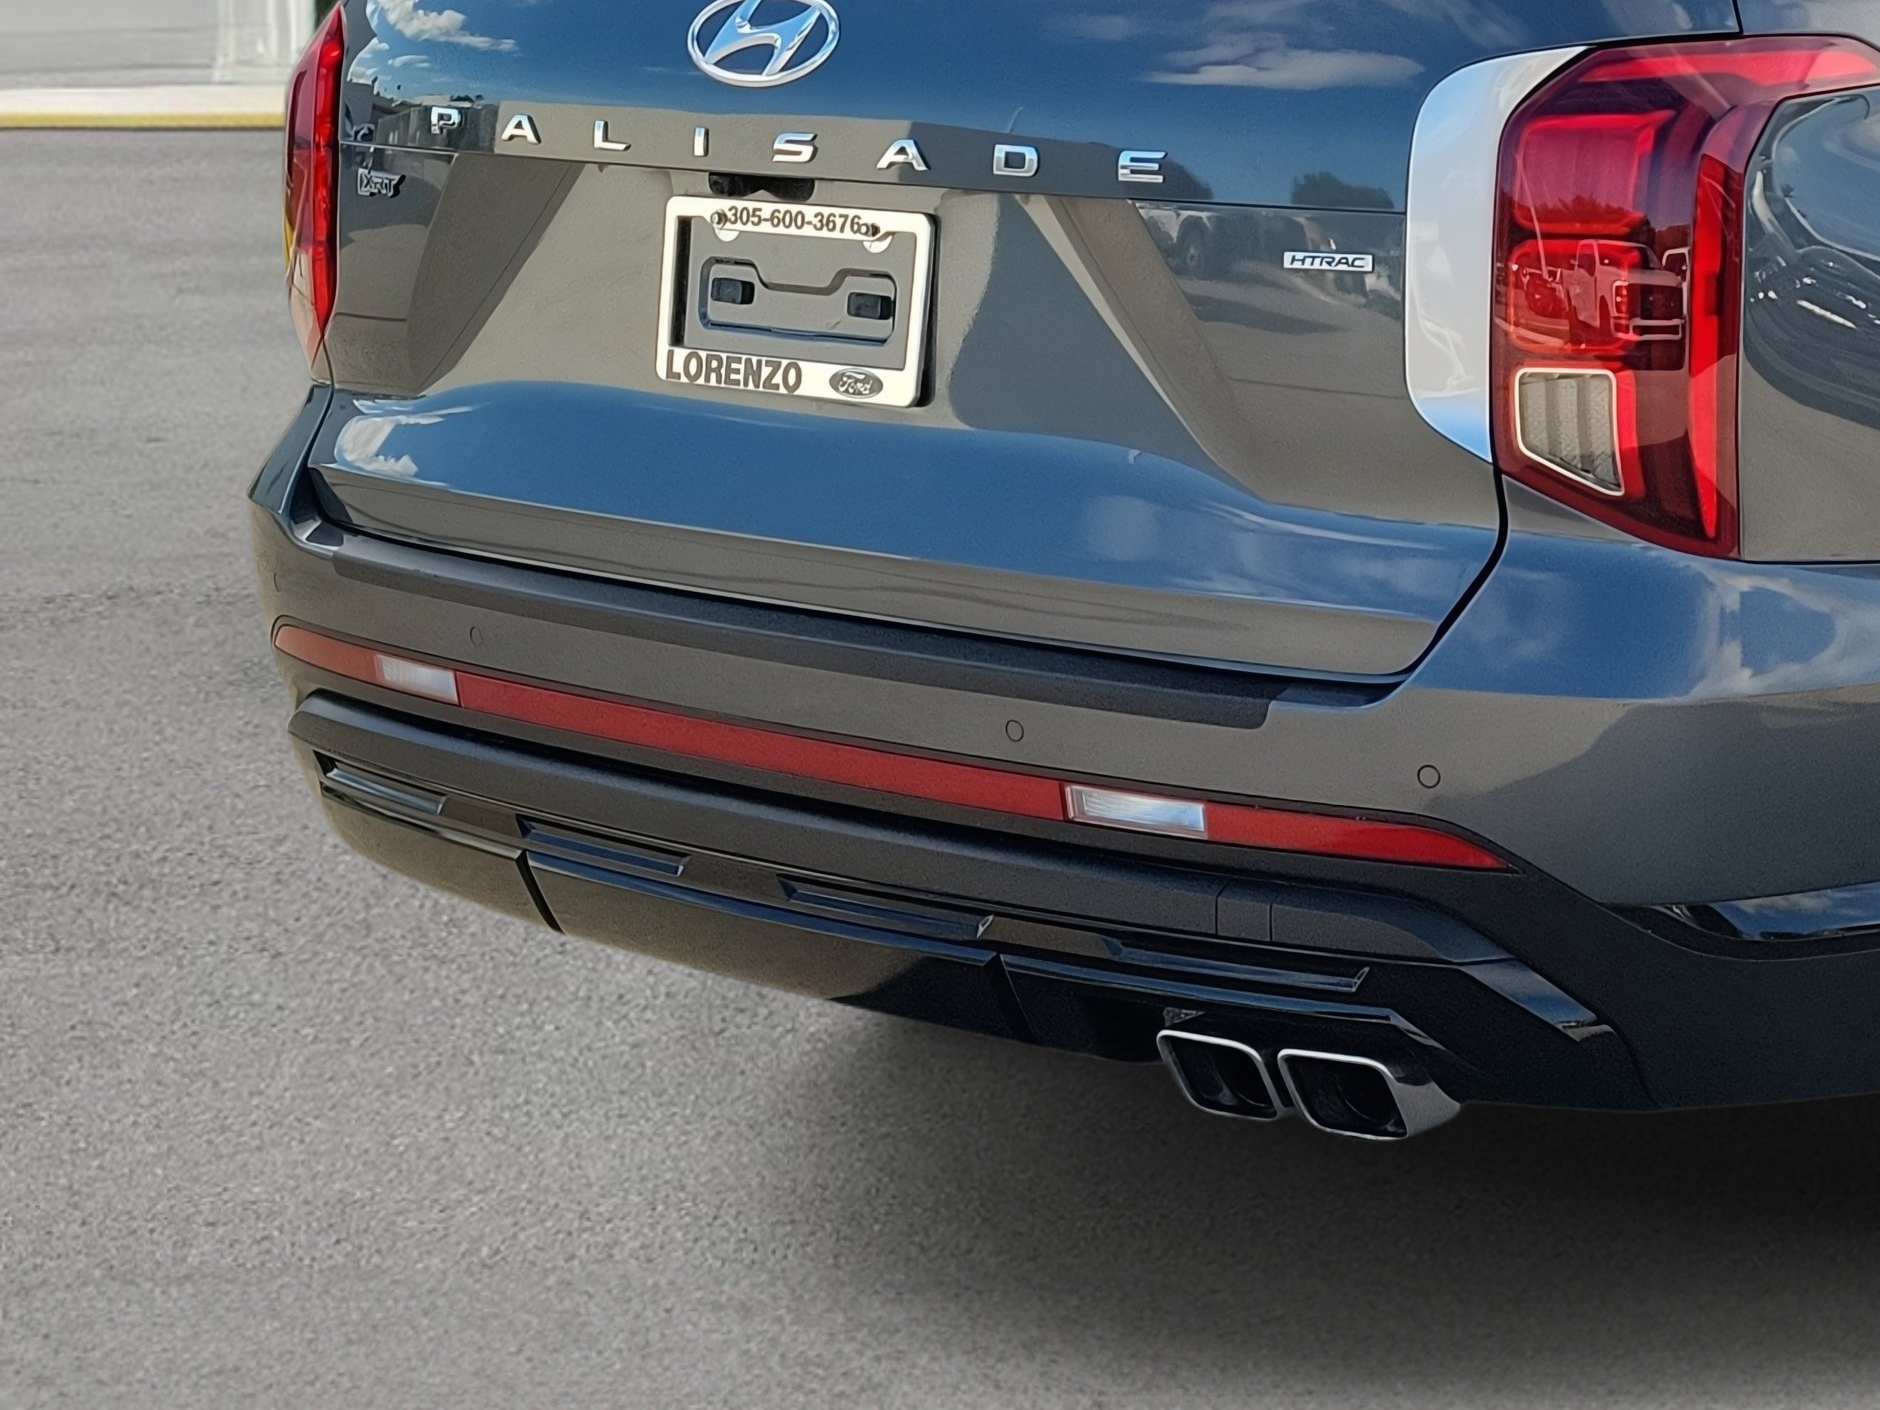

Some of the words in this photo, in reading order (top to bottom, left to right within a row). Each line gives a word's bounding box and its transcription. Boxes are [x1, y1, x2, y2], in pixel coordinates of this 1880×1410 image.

[431, 106, 1170, 185] PALISADE
[727, 205, 861, 234] 305-600-3676
[1289, 254, 1366, 269] HTRAC
[666, 349, 803, 395] LORENZO
